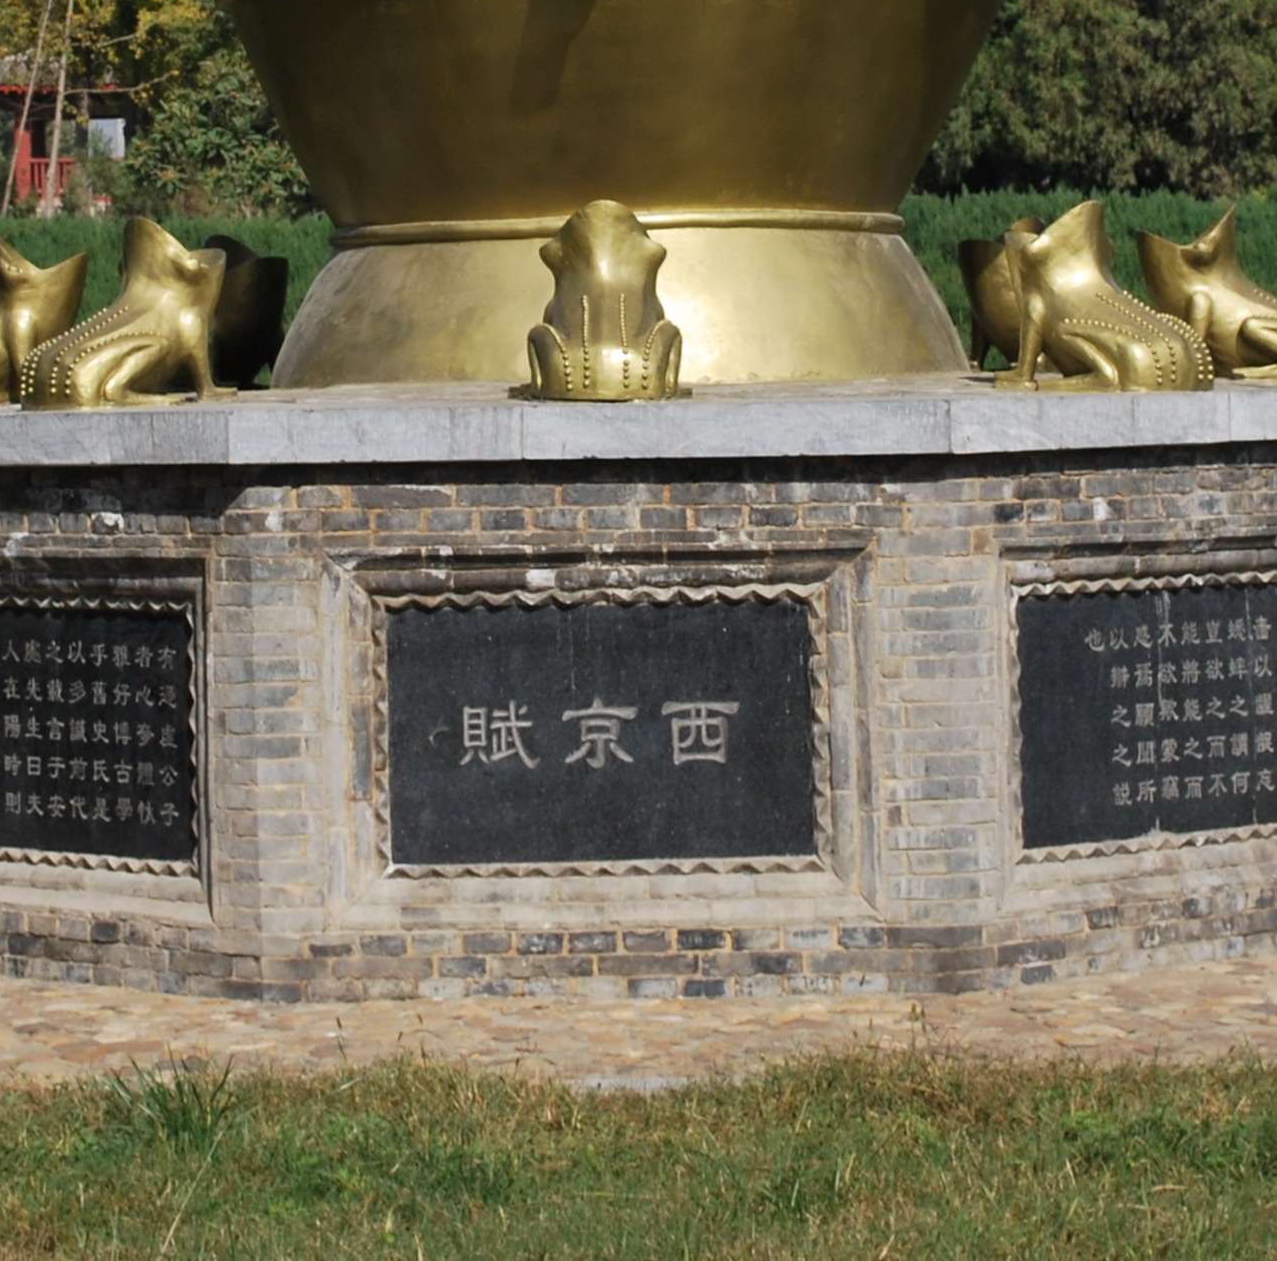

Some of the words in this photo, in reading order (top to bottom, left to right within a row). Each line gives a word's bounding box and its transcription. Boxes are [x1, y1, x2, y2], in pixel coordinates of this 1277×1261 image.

[2, 639, 21, 814] 人在陽時則
[1085, 629, 1105, 652] 也
[1205, 620, 1226, 796] 豈欲之而不
